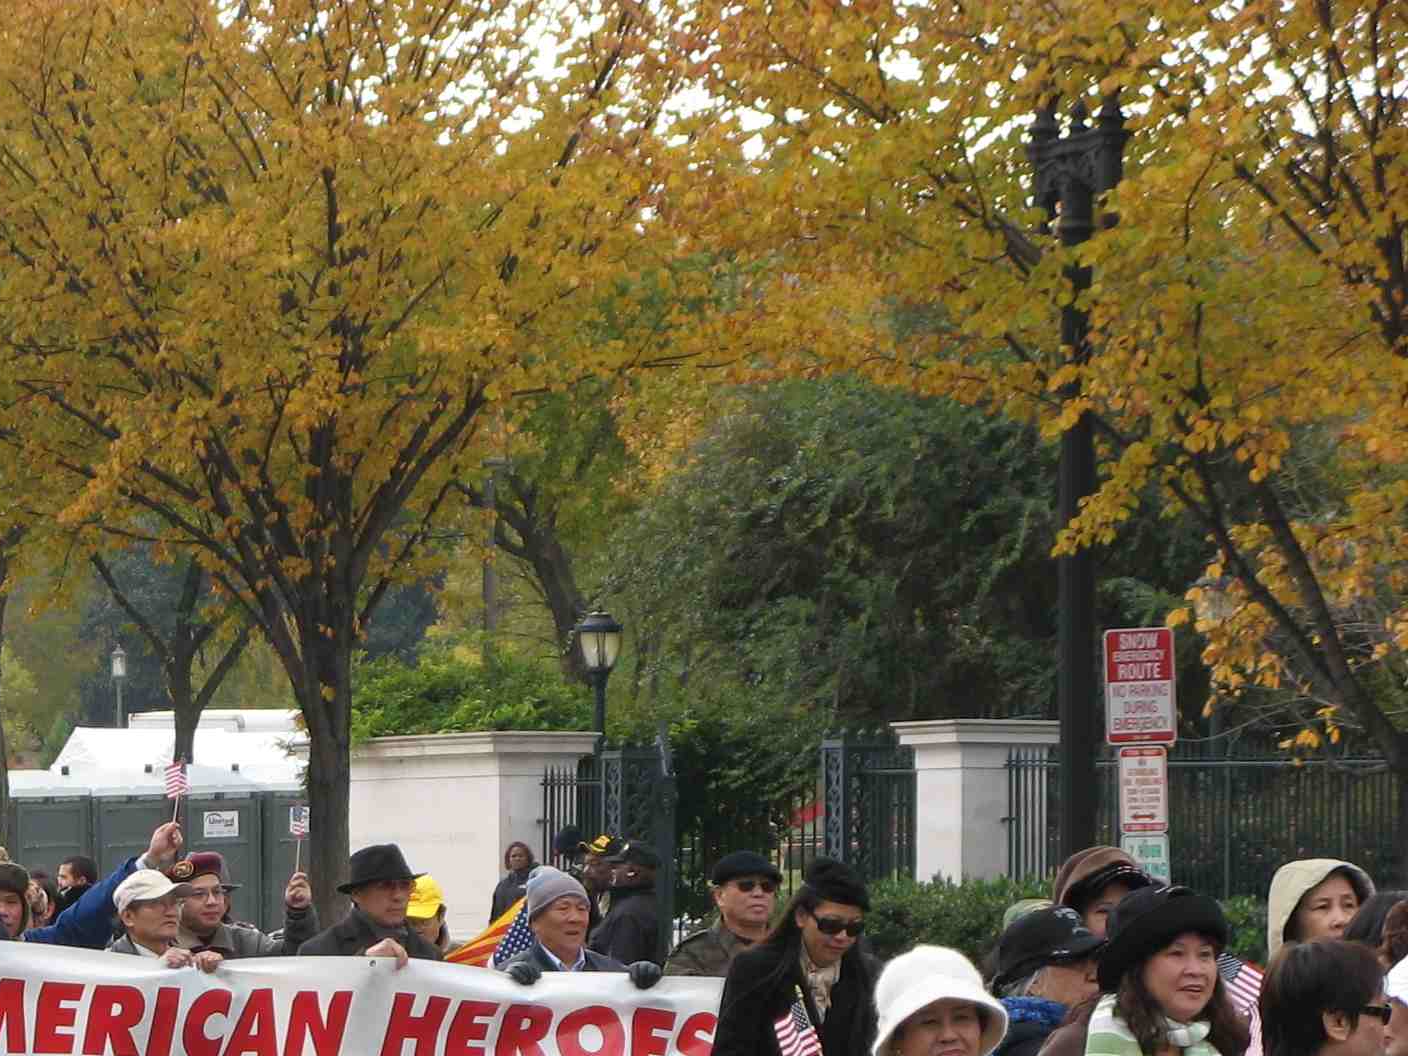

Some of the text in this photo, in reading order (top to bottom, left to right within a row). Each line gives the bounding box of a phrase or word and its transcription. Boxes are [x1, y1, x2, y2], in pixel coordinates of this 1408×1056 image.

[1119, 632, 1158, 649] SNOW
[1118, 663, 1161, 679] ROUTE
[1128, 684, 1169, 697] PARKING
[1123, 700, 1159, 714] DURING
[1112, 716, 1169, 731] EMERGENCY
